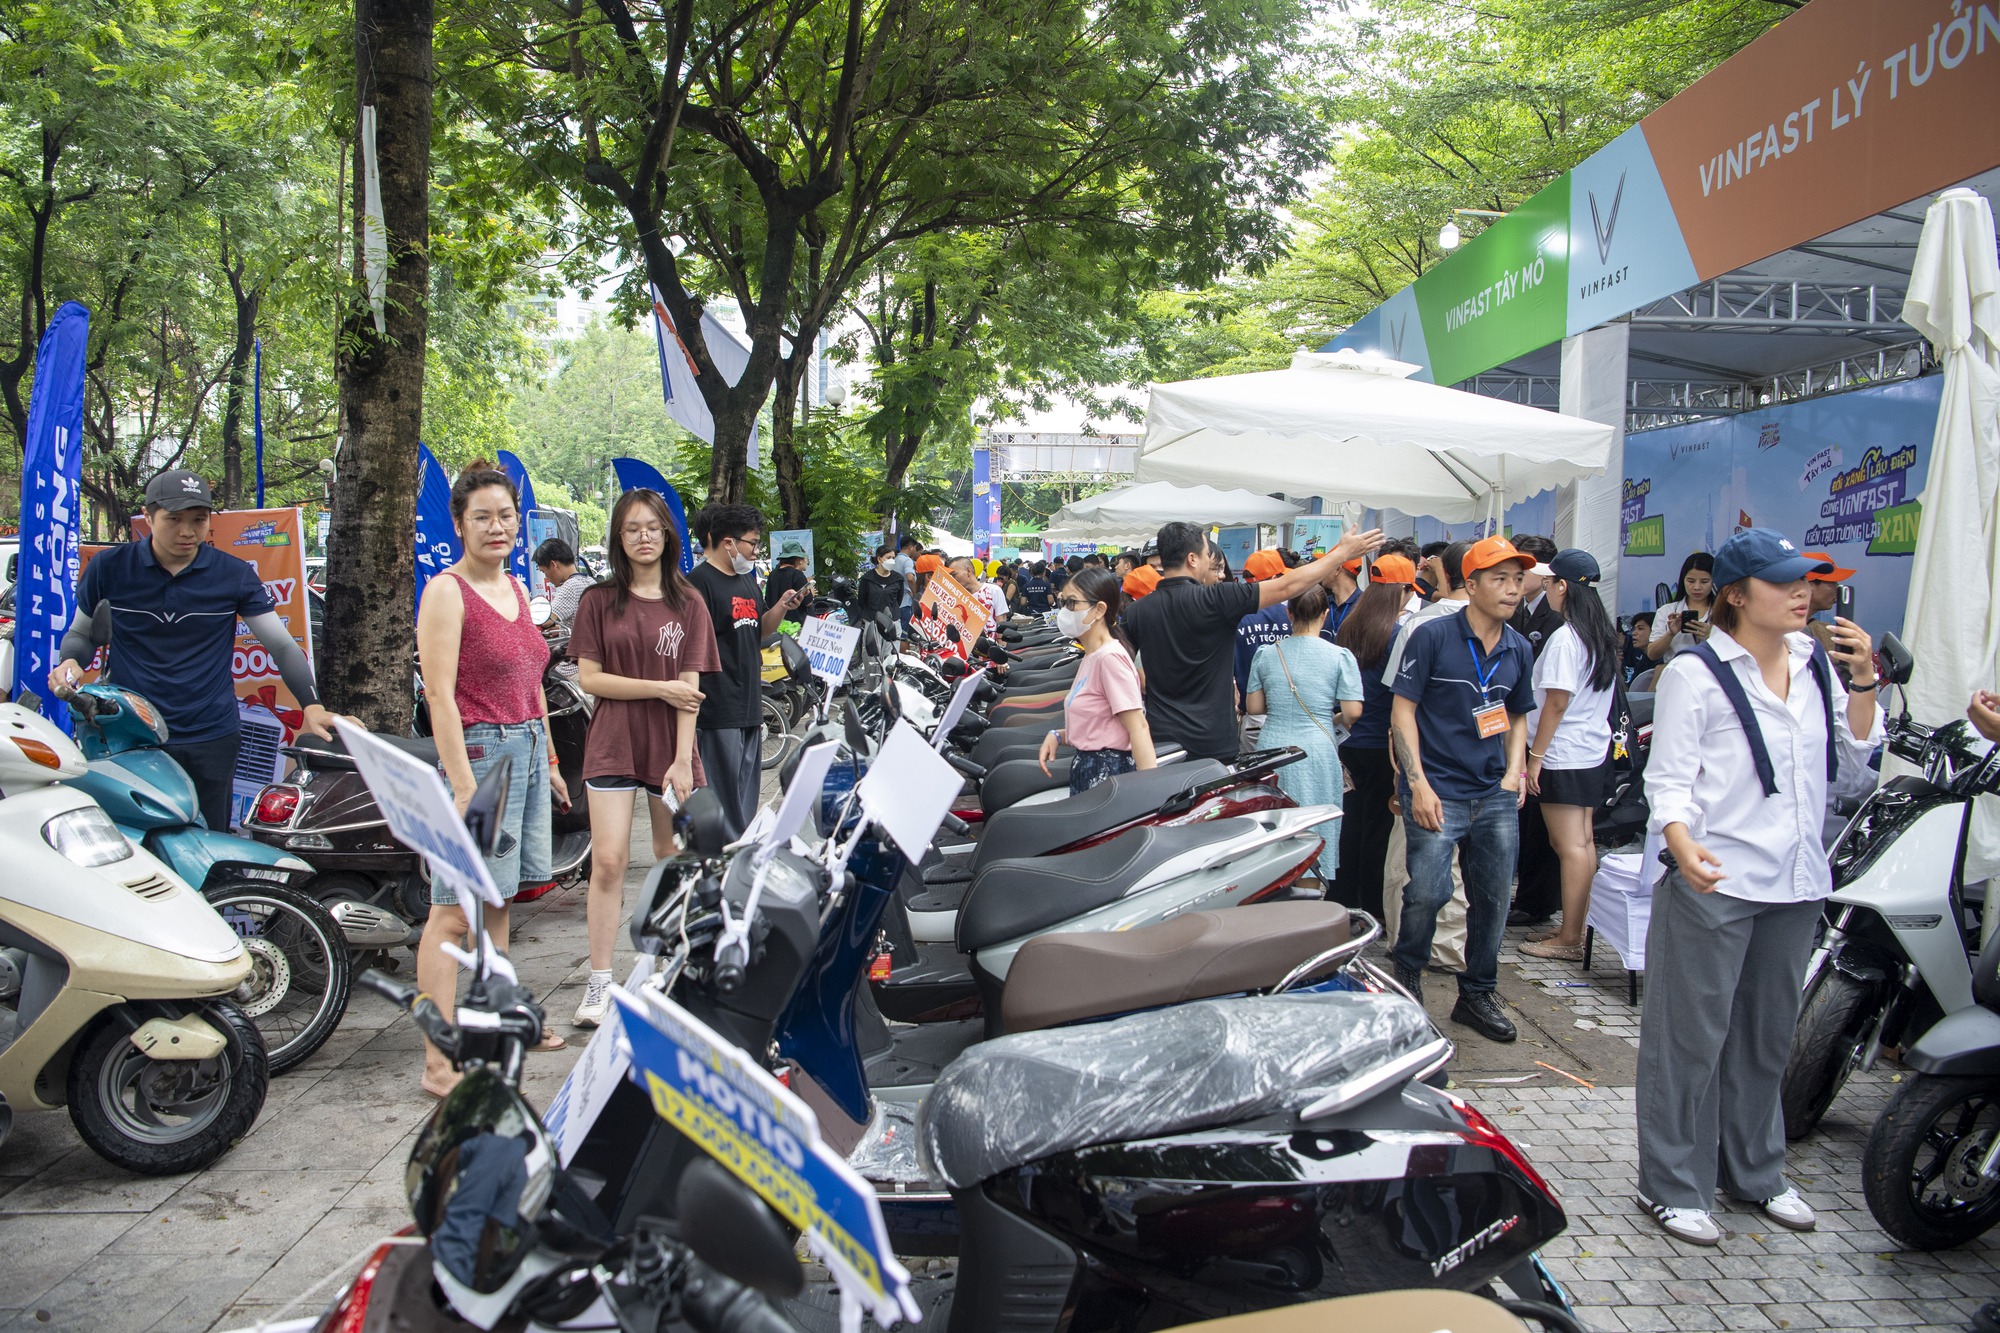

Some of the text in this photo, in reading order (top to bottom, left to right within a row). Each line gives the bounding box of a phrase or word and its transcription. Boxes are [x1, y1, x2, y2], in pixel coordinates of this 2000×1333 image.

[1699, 97, 1821, 198] VINFAST
[1831, 60, 1871, 130] LÝ
[1580, 265, 1629, 300] VINFAST
[1445, 286, 1492, 333] VINFAST
[1495, 269, 1519, 307] TÂY
[1681, 441, 1710, 454] VINFAST
[1804, 467, 1819, 483] TÂY
[1630, 524, 1660, 548] XANH
[31, 470, 47, 674] VINFAST
[930, 581, 940, 596] THU
[940, 588, 948, 603] XE
[942, 576, 963, 598] VINFAST
[968, 601, 987, 621] TƯỞNG
[824, 623, 847, 633] VINFAST
[962, 630, 973, 642] CAO
[1238, 622, 1292, 636] VINFAS
[1246, 634, 1256, 645] LÝ
[806, 634, 843, 654] FELIZ Neo
[675, 1048, 805, 1170] MOTIO
[1430, 1218, 1504, 1278] VENTO
